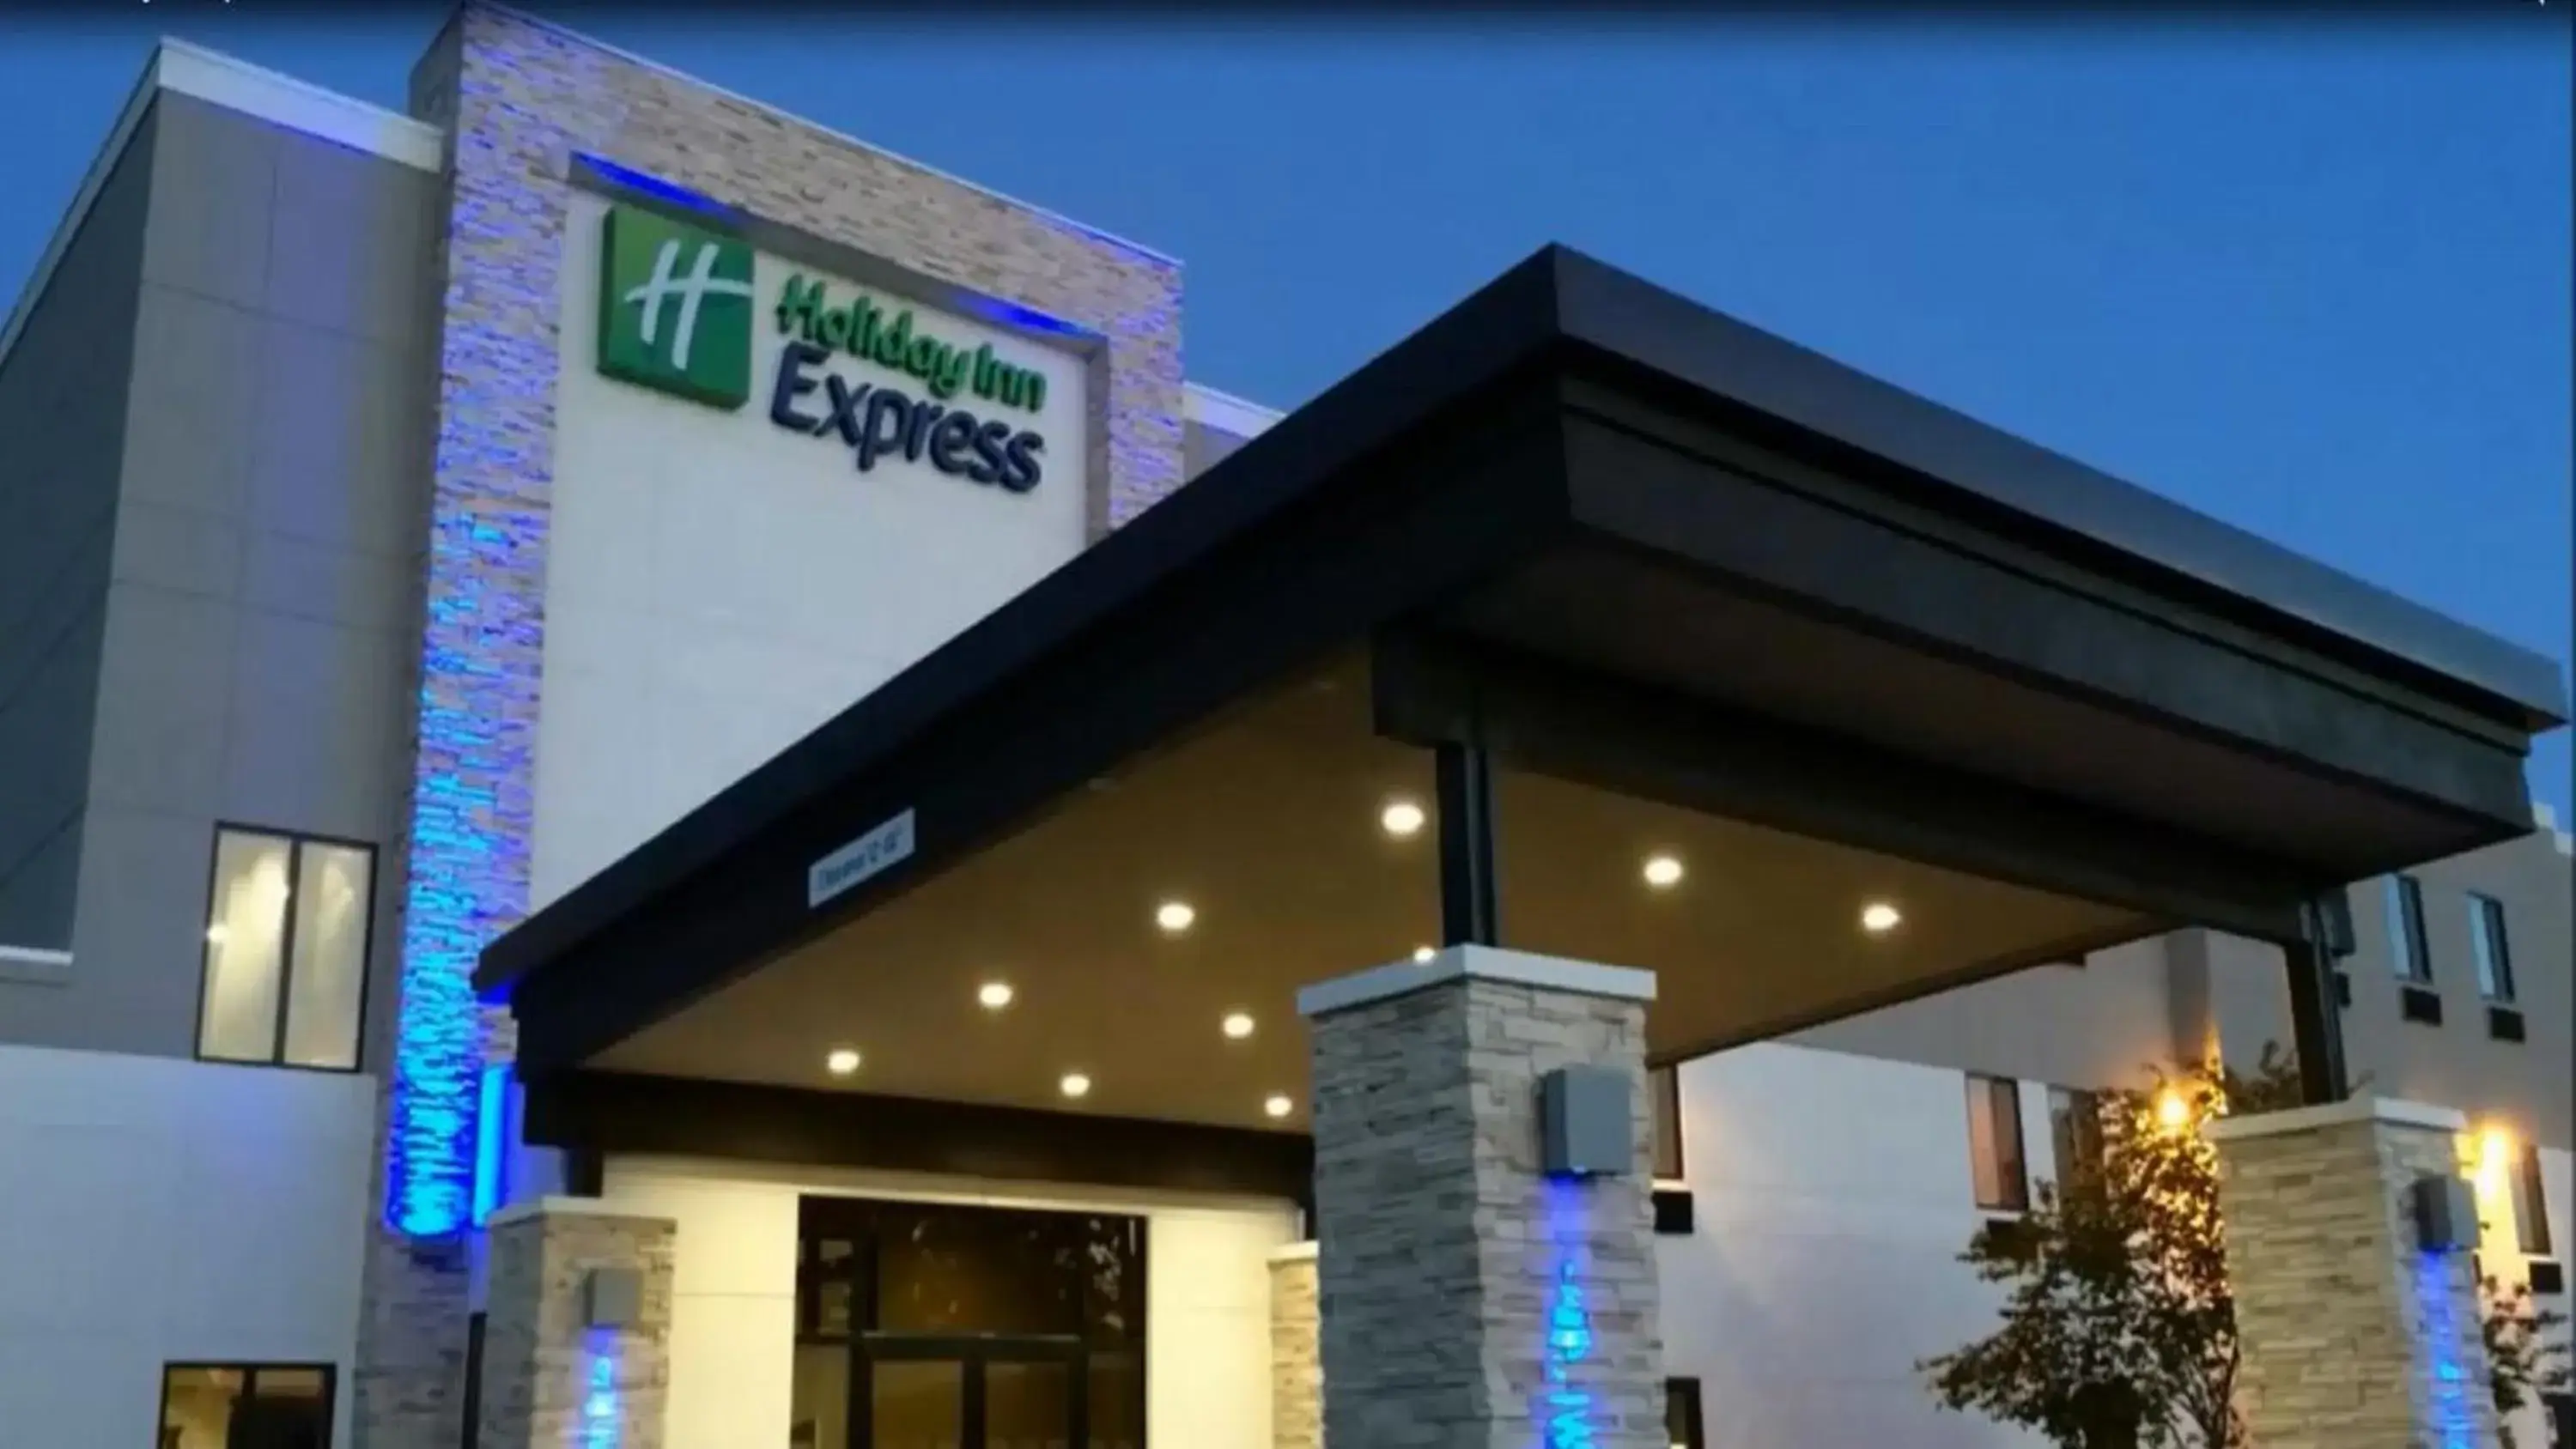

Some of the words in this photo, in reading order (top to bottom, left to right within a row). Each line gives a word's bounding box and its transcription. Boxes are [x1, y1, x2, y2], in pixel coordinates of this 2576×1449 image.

[625, 239, 752, 370] H
[775, 273, 969, 399] Holiday
[973, 342, 1047, 411] Inn
[769, 340, 1043, 493] Express
